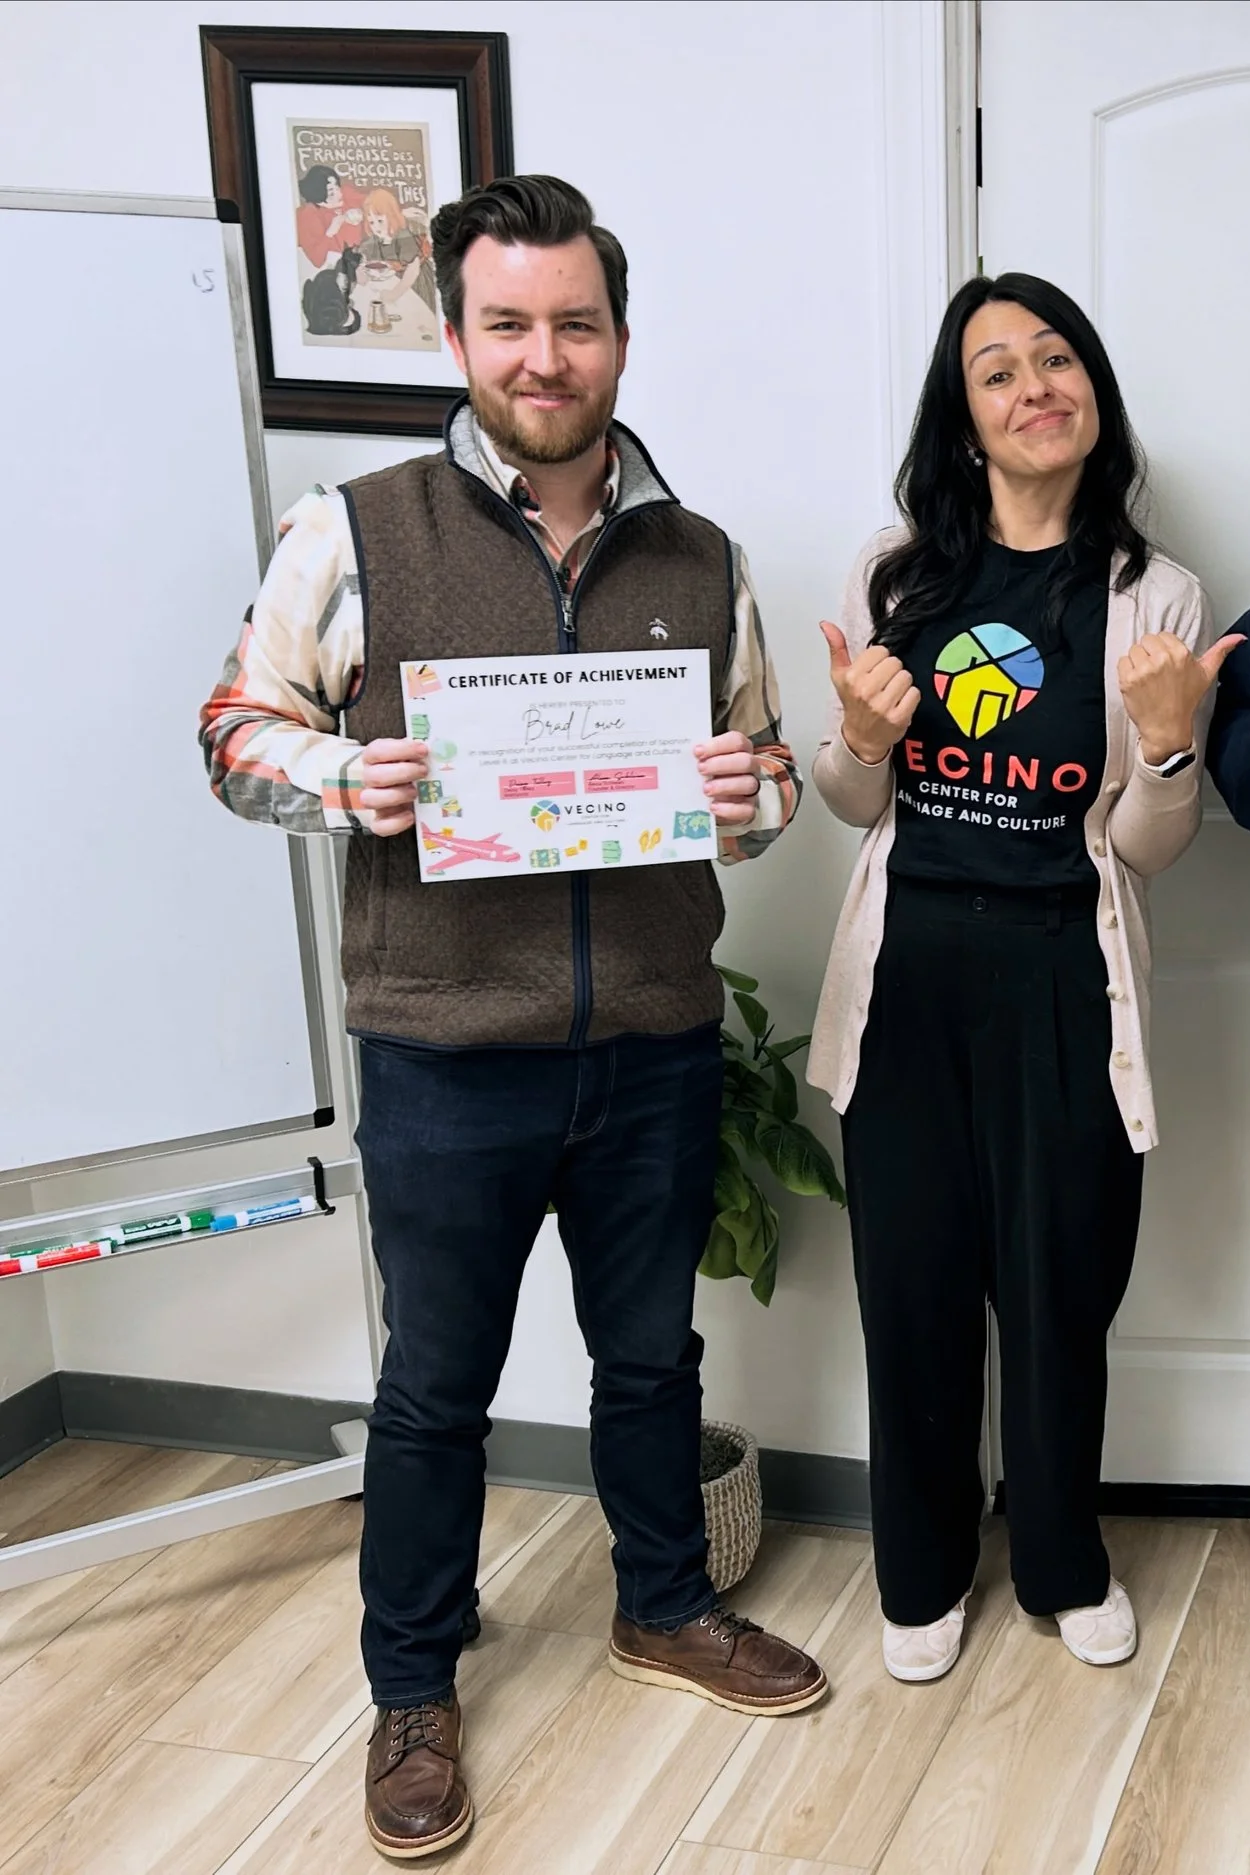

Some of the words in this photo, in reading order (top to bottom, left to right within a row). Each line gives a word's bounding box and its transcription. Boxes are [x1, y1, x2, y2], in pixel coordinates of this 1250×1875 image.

[296, 130, 392, 147] COMPAGNIE
[392, 151, 414, 161] DES
[334, 161, 422, 180] CHOCOLATS
[354, 178, 368, 187] ET
[372, 178, 393, 187] DES
[448, 672, 548, 688] CERTIFICATE
[553, 671, 573, 684] OF
[579, 667, 687, 682] ACHIEVEMENT
[905, 739, 1087, 792] ECINO
[919, 781, 980, 802] CENTER
[985, 792, 1018, 809] FOR
[564, 802, 626, 814] VECINO
[897, 789, 954, 819] ANAGE
[958, 809, 993, 826] AND
[997, 815, 1067, 831] CULTURE
